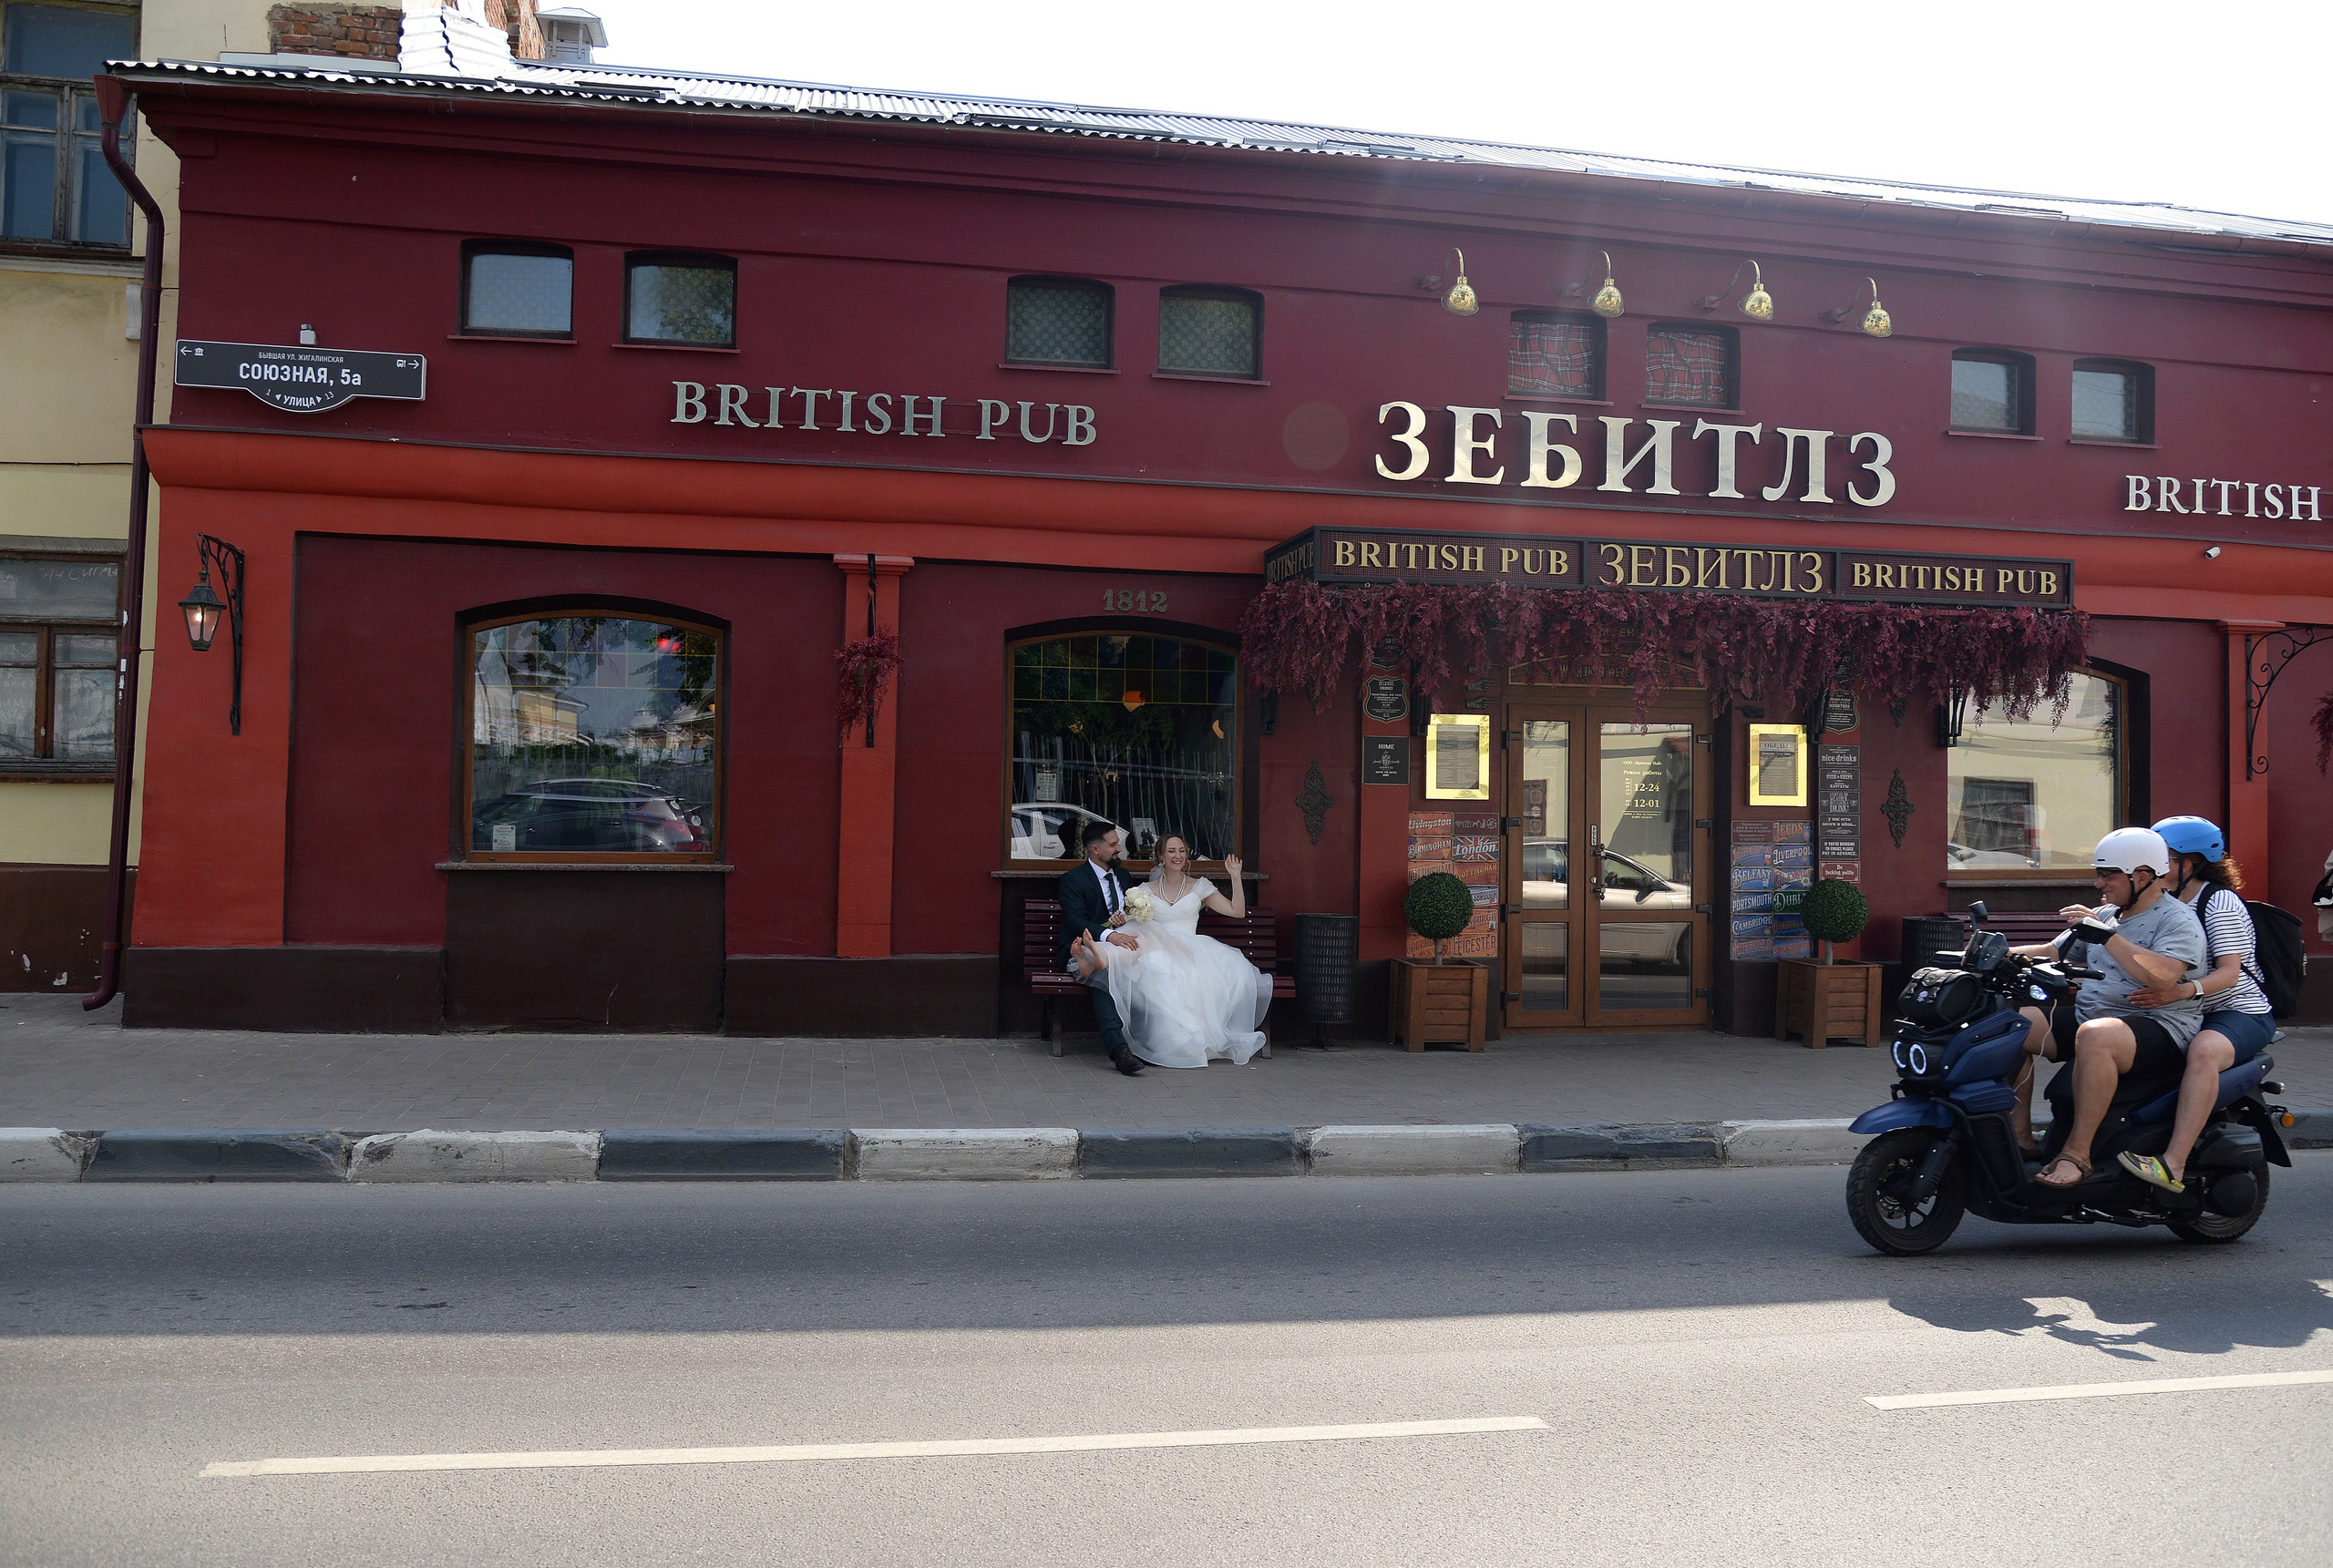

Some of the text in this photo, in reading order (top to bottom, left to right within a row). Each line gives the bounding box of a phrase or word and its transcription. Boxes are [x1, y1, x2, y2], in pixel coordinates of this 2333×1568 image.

[259, 352, 344, 364] БЫВШАЯ УЛ. ЖИГАЛИНСКАЯ
[239, 363, 362, 386] СОЮЗНАЯ, 5а
[265, 388, 334, 408] 1 УЛИЦА 13
[670, 380, 1097, 446] BRITISH PUB
[1374, 401, 1897, 507] ЗЕБИТЛЗ
[2124, 475, 2322, 521] BRITISH
[1333, 540, 1569, 575] BRITISH PUB
[1598, 543, 1824, 593] ЗЕБИТЛЗ
[1853, 562, 2058, 595] BRITISH PUB
[1103, 589, 1167, 613] 1812
[1821, 753, 1857, 763] nice drinks
[1633, 783, 1660, 793] 12-24
[1633, 798, 1660, 808] 12-01
[1829, 804, 1850, 813] DRINK!
[1408, 818, 1452, 830] Livingston
[1773, 822, 1804, 843] LEEDS
[1408, 839, 1496, 858] BIRMINGHAM London
[1773, 845, 1813, 865] LIVERPOOL
[1408, 863, 1497, 882] NOTTINGHAM NOTTINGHAM
[1732, 868, 1773, 888] BELFAST
[1732, 893, 1773, 912] PORTSMOUTH
[1732, 916, 1773, 936] CAMBRIDGE
[1453, 935, 1496, 956] LEICESTER
[1732, 938, 1773, 958] SHEFFIELD
